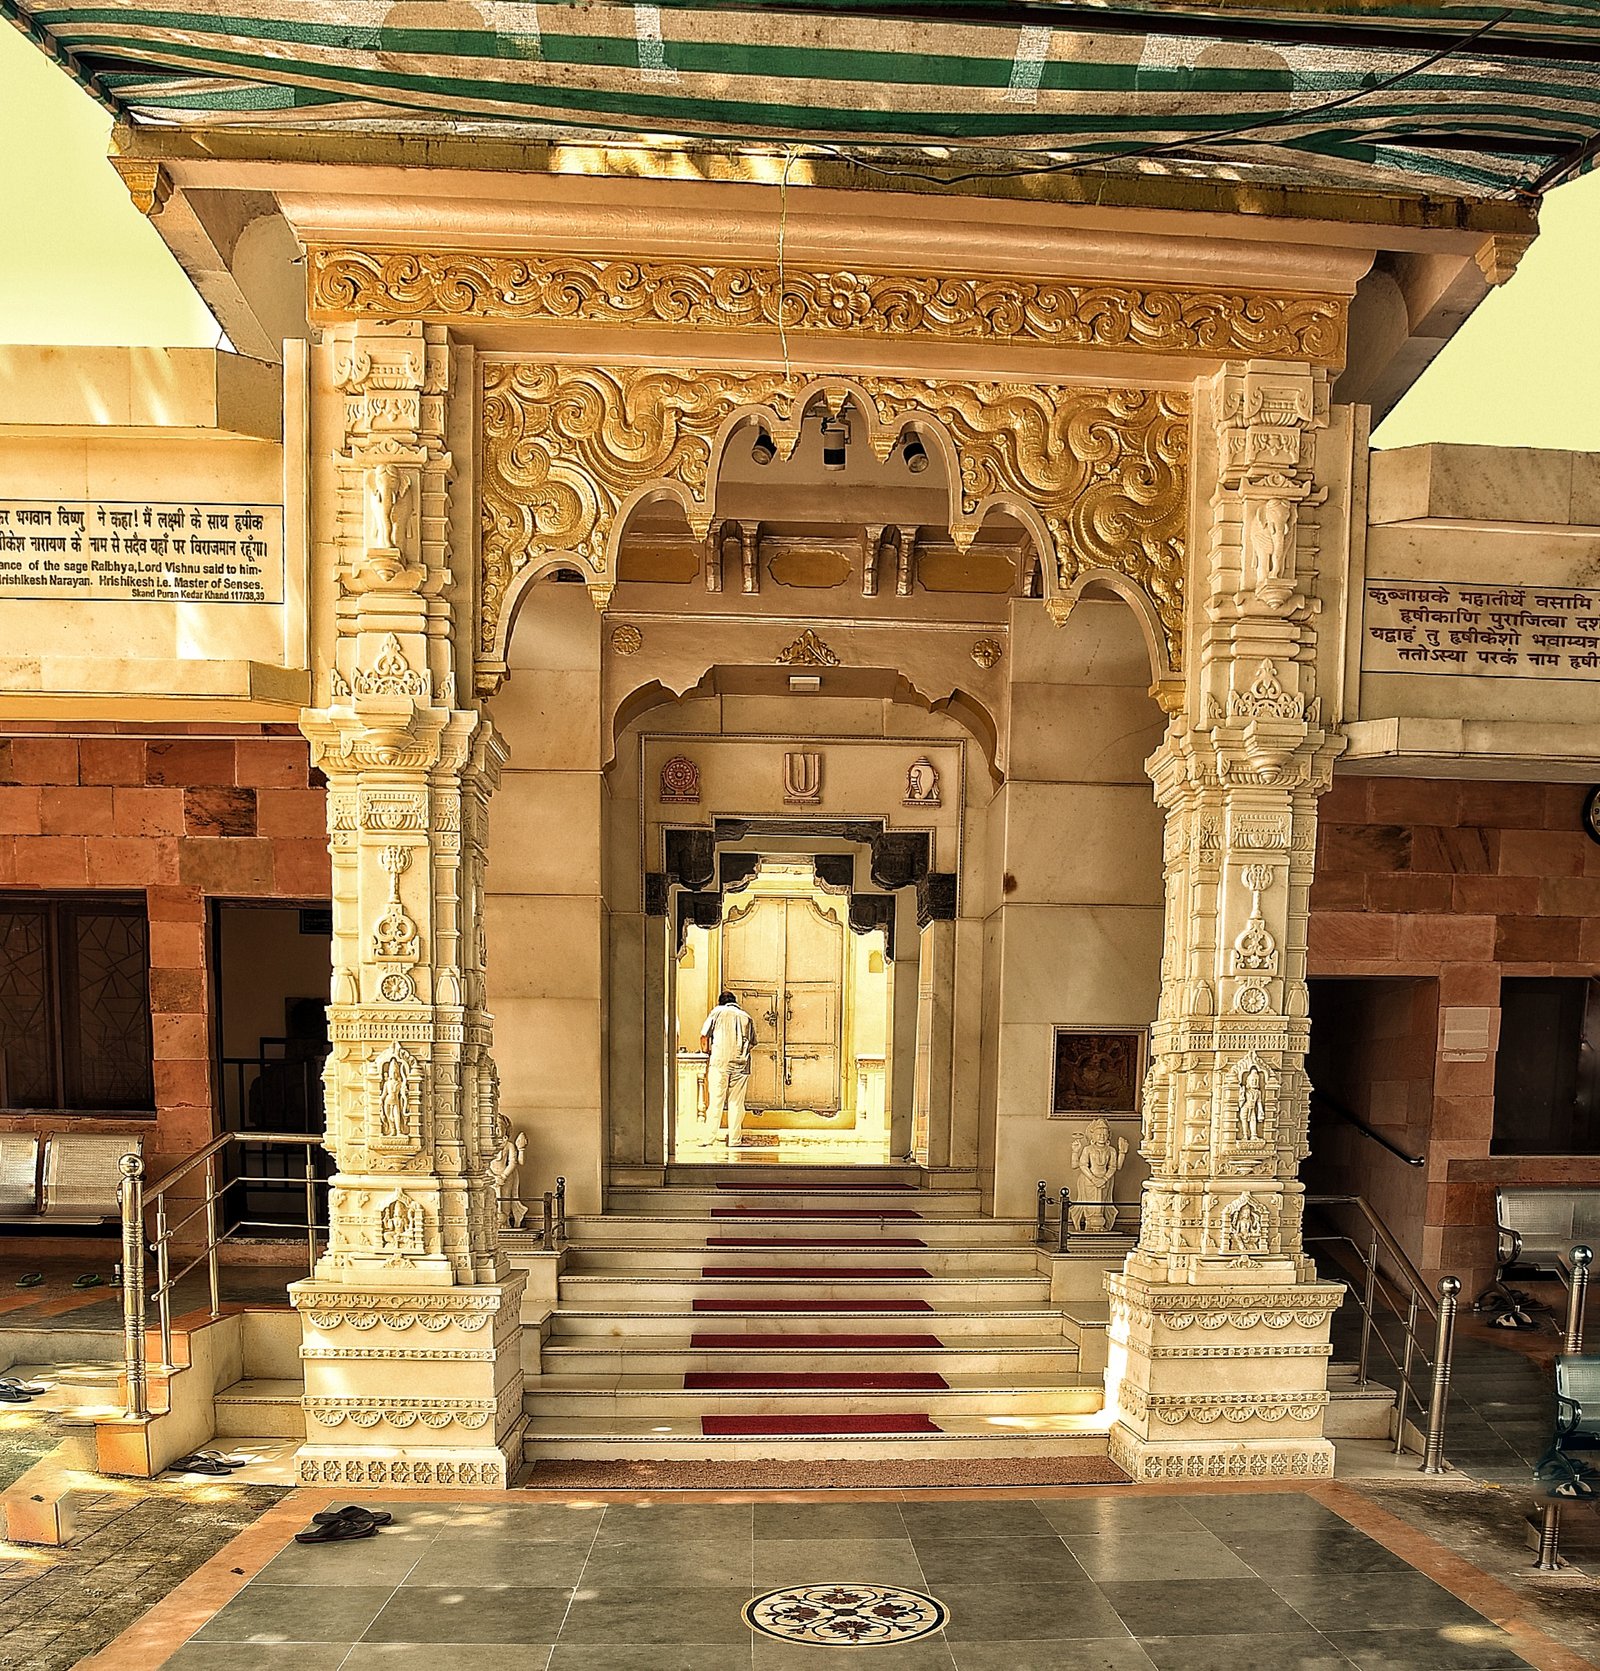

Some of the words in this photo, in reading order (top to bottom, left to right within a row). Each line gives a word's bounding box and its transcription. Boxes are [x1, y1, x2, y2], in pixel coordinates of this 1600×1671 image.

[16, 511, 52, 525] भगवान
[57, 506, 85, 532] विष्णु
[97, 505, 106, 526] ने
[143, 506, 152, 527] मैं
[157, 508, 185, 531] लक्ष्मी
[190, 508, 202, 528] के
[206, 514, 229, 530] साथ
[234, 510, 263, 532] हृषीक
[0, 530, 26, 552] ीकेश
[30, 537, 66, 552] नारायण
[70, 531, 82, 552] के
[89, 537, 107, 552] नाम
[110, 531, 120, 553] से
[123, 532, 147, 555] सदैव
[150, 532, 168, 556] यहाँ
[173, 540, 186, 555] पर
[190, 534, 236, 556] विराजमान
[28, 560, 39, 570] of
[43, 560, 60, 571] the
[64, 562, 88, 573] sage
[165, 562, 200, 573] Vishnu
[203, 563, 224, 575] said
[226, 564, 237, 575] to
[0, 574, 47, 585] rishikesh
[50, 575, 93, 588] Narayan.
[99, 575, 154, 587] Hrishikesh
[156, 577, 171, 588] i.e.
[174, 577, 208, 588] Master
[211, 578, 221, 589] of
[223, 578, 263, 590] Senses.
[131, 588, 155, 598] Skand
[157, 589, 179, 599] Puran
[180, 590, 203, 600] Kedar
[204, 591, 229, 600] Khand
[1459, 590, 1526, 606] महातीर्थे
[1534, 593, 1592, 609] वसामि
[1399, 606, 1481, 624] हृषीकाणि
[1489, 610, 1568, 630] पुराजित्वा
[1425, 629, 1440, 646] तु
[1448, 627, 1522, 646] हृषीकेशो
[1476, 648, 1518, 664] परकं
[1527, 653, 1561, 666] नाम
[1568, 651, 1600, 669] हृषी
